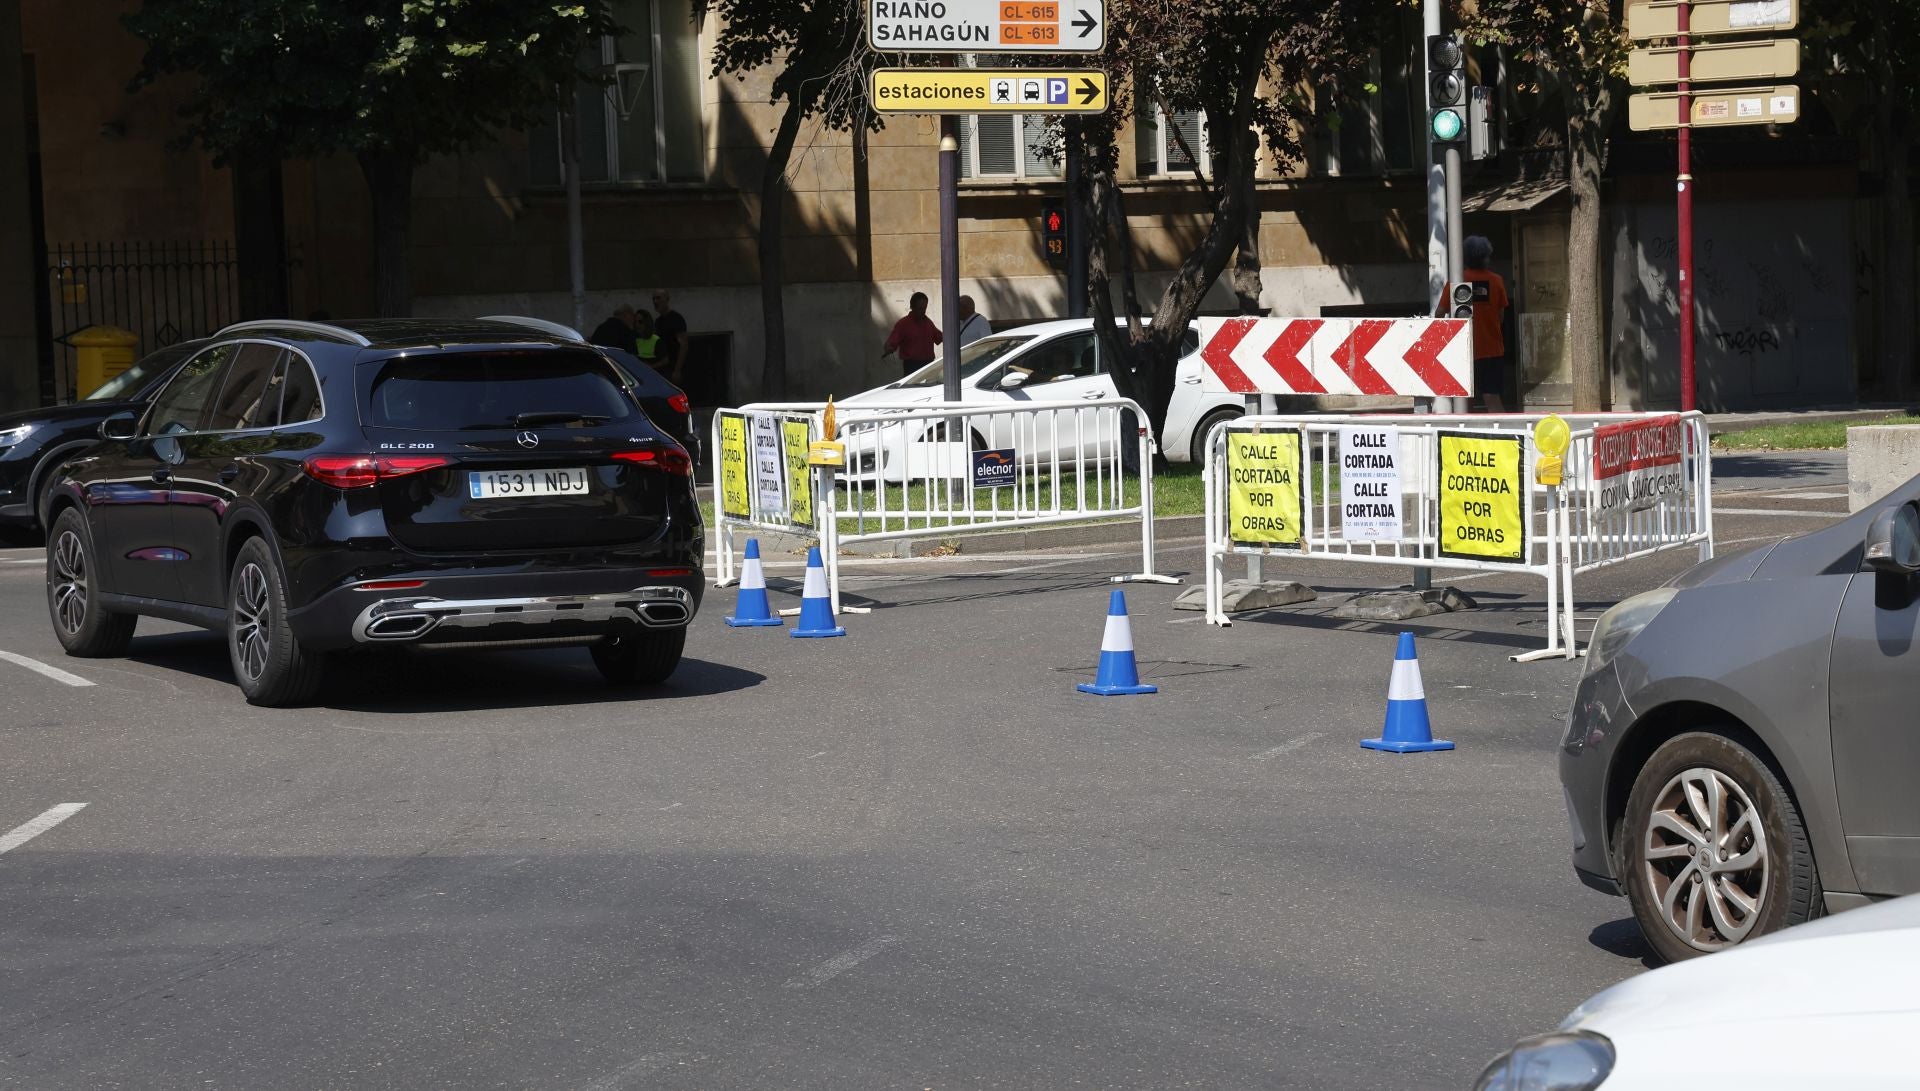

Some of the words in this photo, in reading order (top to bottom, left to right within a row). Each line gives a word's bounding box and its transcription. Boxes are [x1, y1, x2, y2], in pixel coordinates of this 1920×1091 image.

[876, 20, 990, 42] SAHAGÚN
[879, 82, 986, 100] estaciones
[1050, 80, 1067, 102] P
[1048, 239, 1062, 254] 43
[1352, 433, 1387, 448] CALLE
[1240, 445, 1278, 460] CALLE
[1458, 450, 1496, 468] CALLE
[977, 463, 1013, 476] elecnor
[1344, 454, 1395, 469] CORTADA
[488, 472, 537, 496] 1531
[546, 471, 586, 493] NDJ
[1234, 467, 1292, 484] CORTADA
[1354, 482, 1388, 497] CALLE
[1447, 474, 1511, 494] CORTADA
[1249, 492, 1274, 507] POR
[1346, 503, 1396, 518] CORTADA
[1463, 501, 1492, 518] POR
[1242, 515, 1286, 531] OBRAS
[1456, 525, 1505, 544] OBRAS
